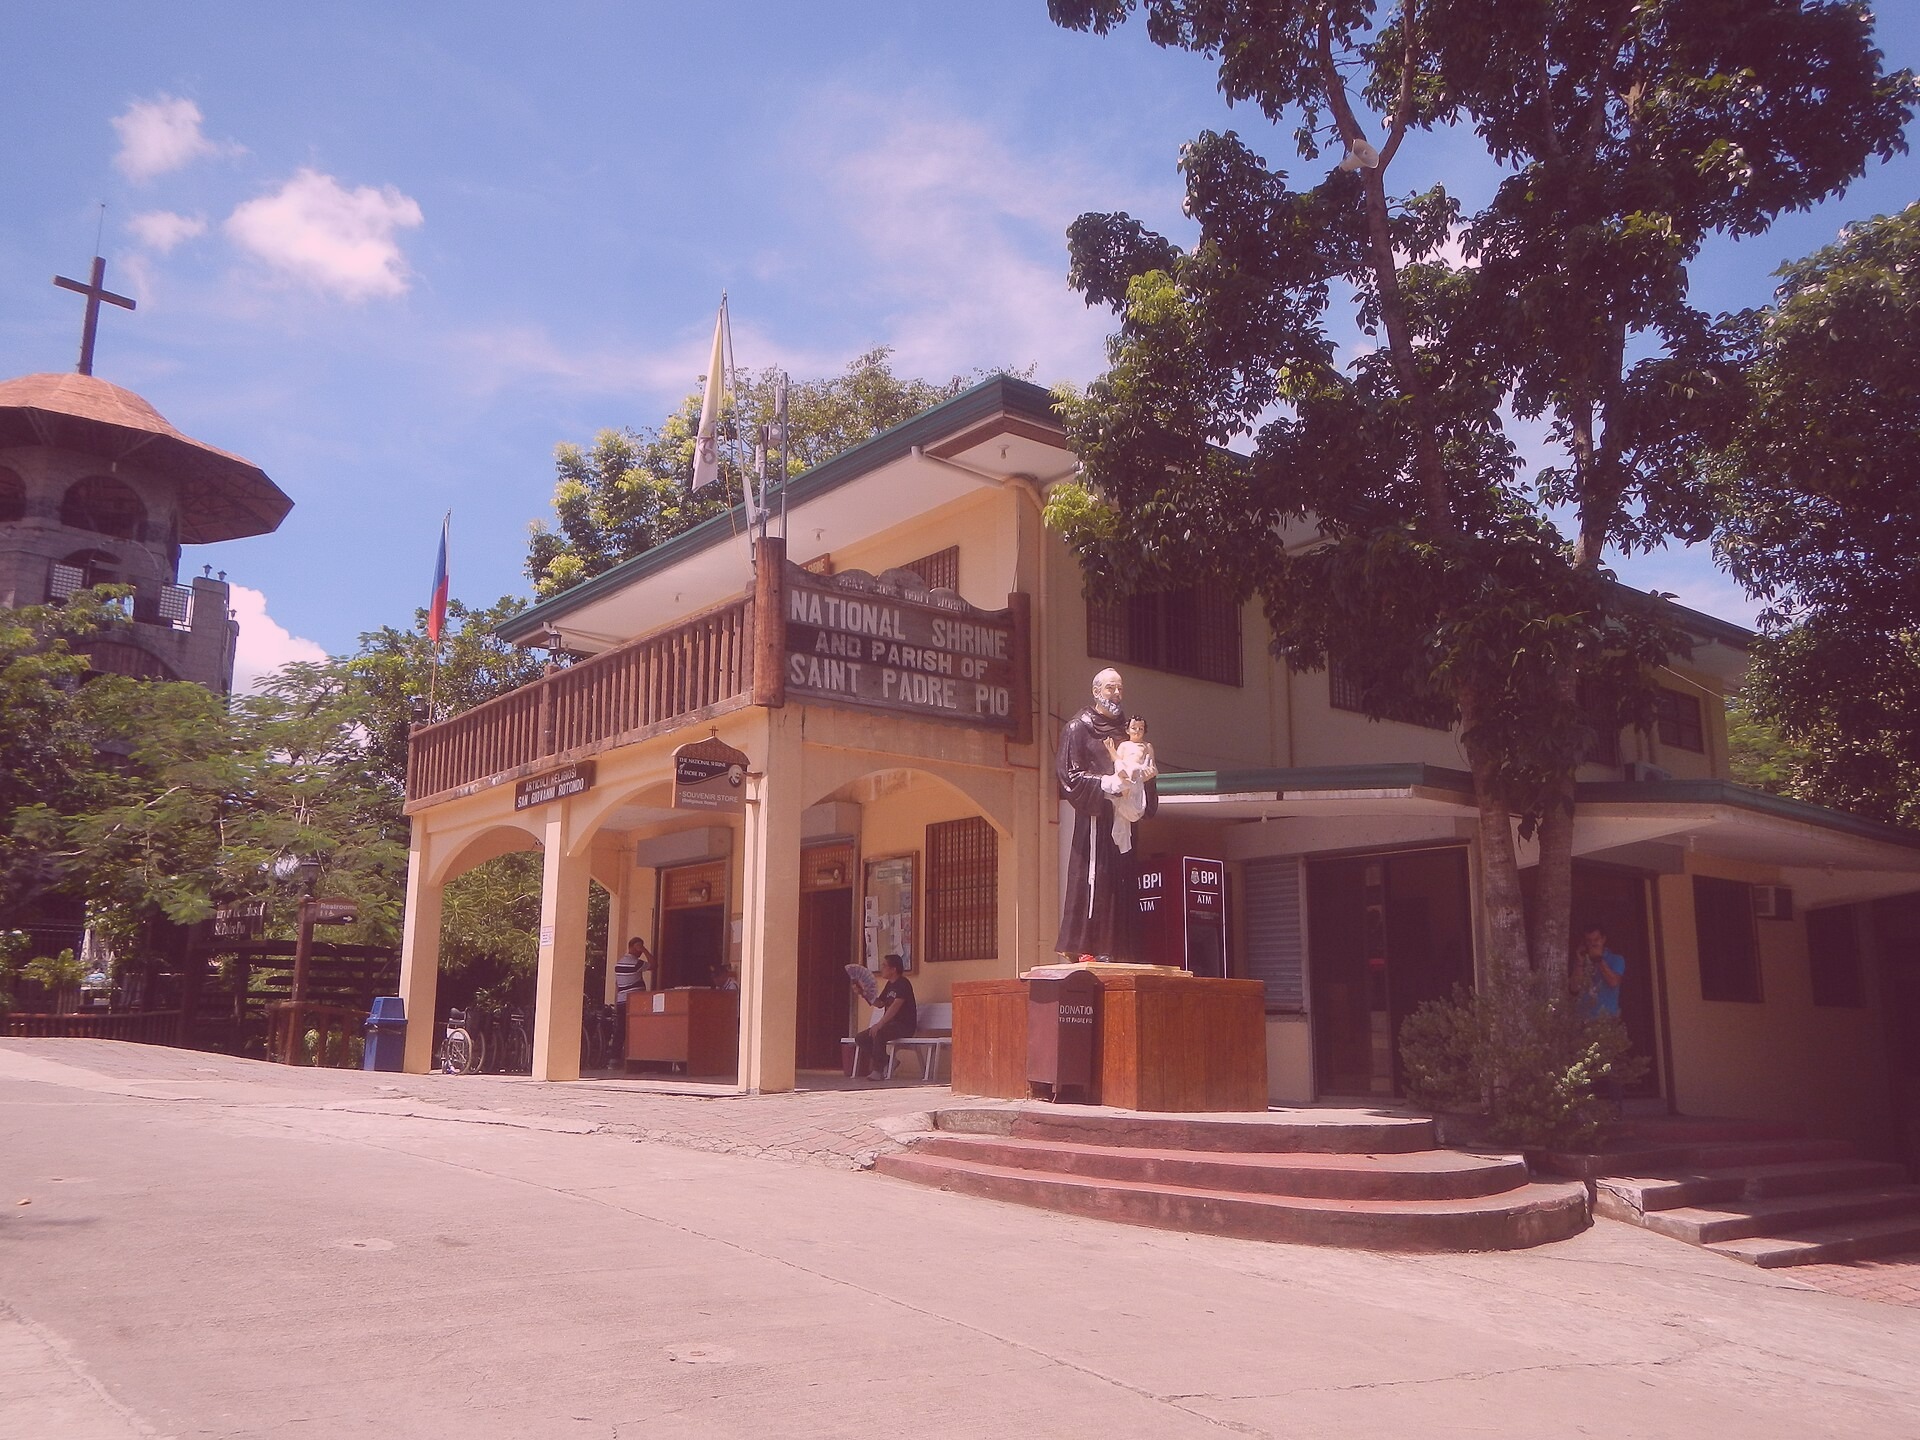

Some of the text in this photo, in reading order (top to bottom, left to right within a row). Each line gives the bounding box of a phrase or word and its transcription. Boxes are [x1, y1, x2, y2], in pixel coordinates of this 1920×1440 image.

[791, 589, 1008, 660] NATIONAL SHRINE
[815, 631, 988, 680] AND PARISH OF
[790, 653, 1009, 716] SAINT PADRE PIO
[518, 778, 584, 808] SAN GIOVANNI ROTONDO
[682, 790, 716, 801] SOUVENIR
[716, 794, 738, 803] STORE
[1142, 872, 1162, 889] BPI
[1201, 870, 1217, 885] BPI
[1197, 894, 1212, 905] ATM
